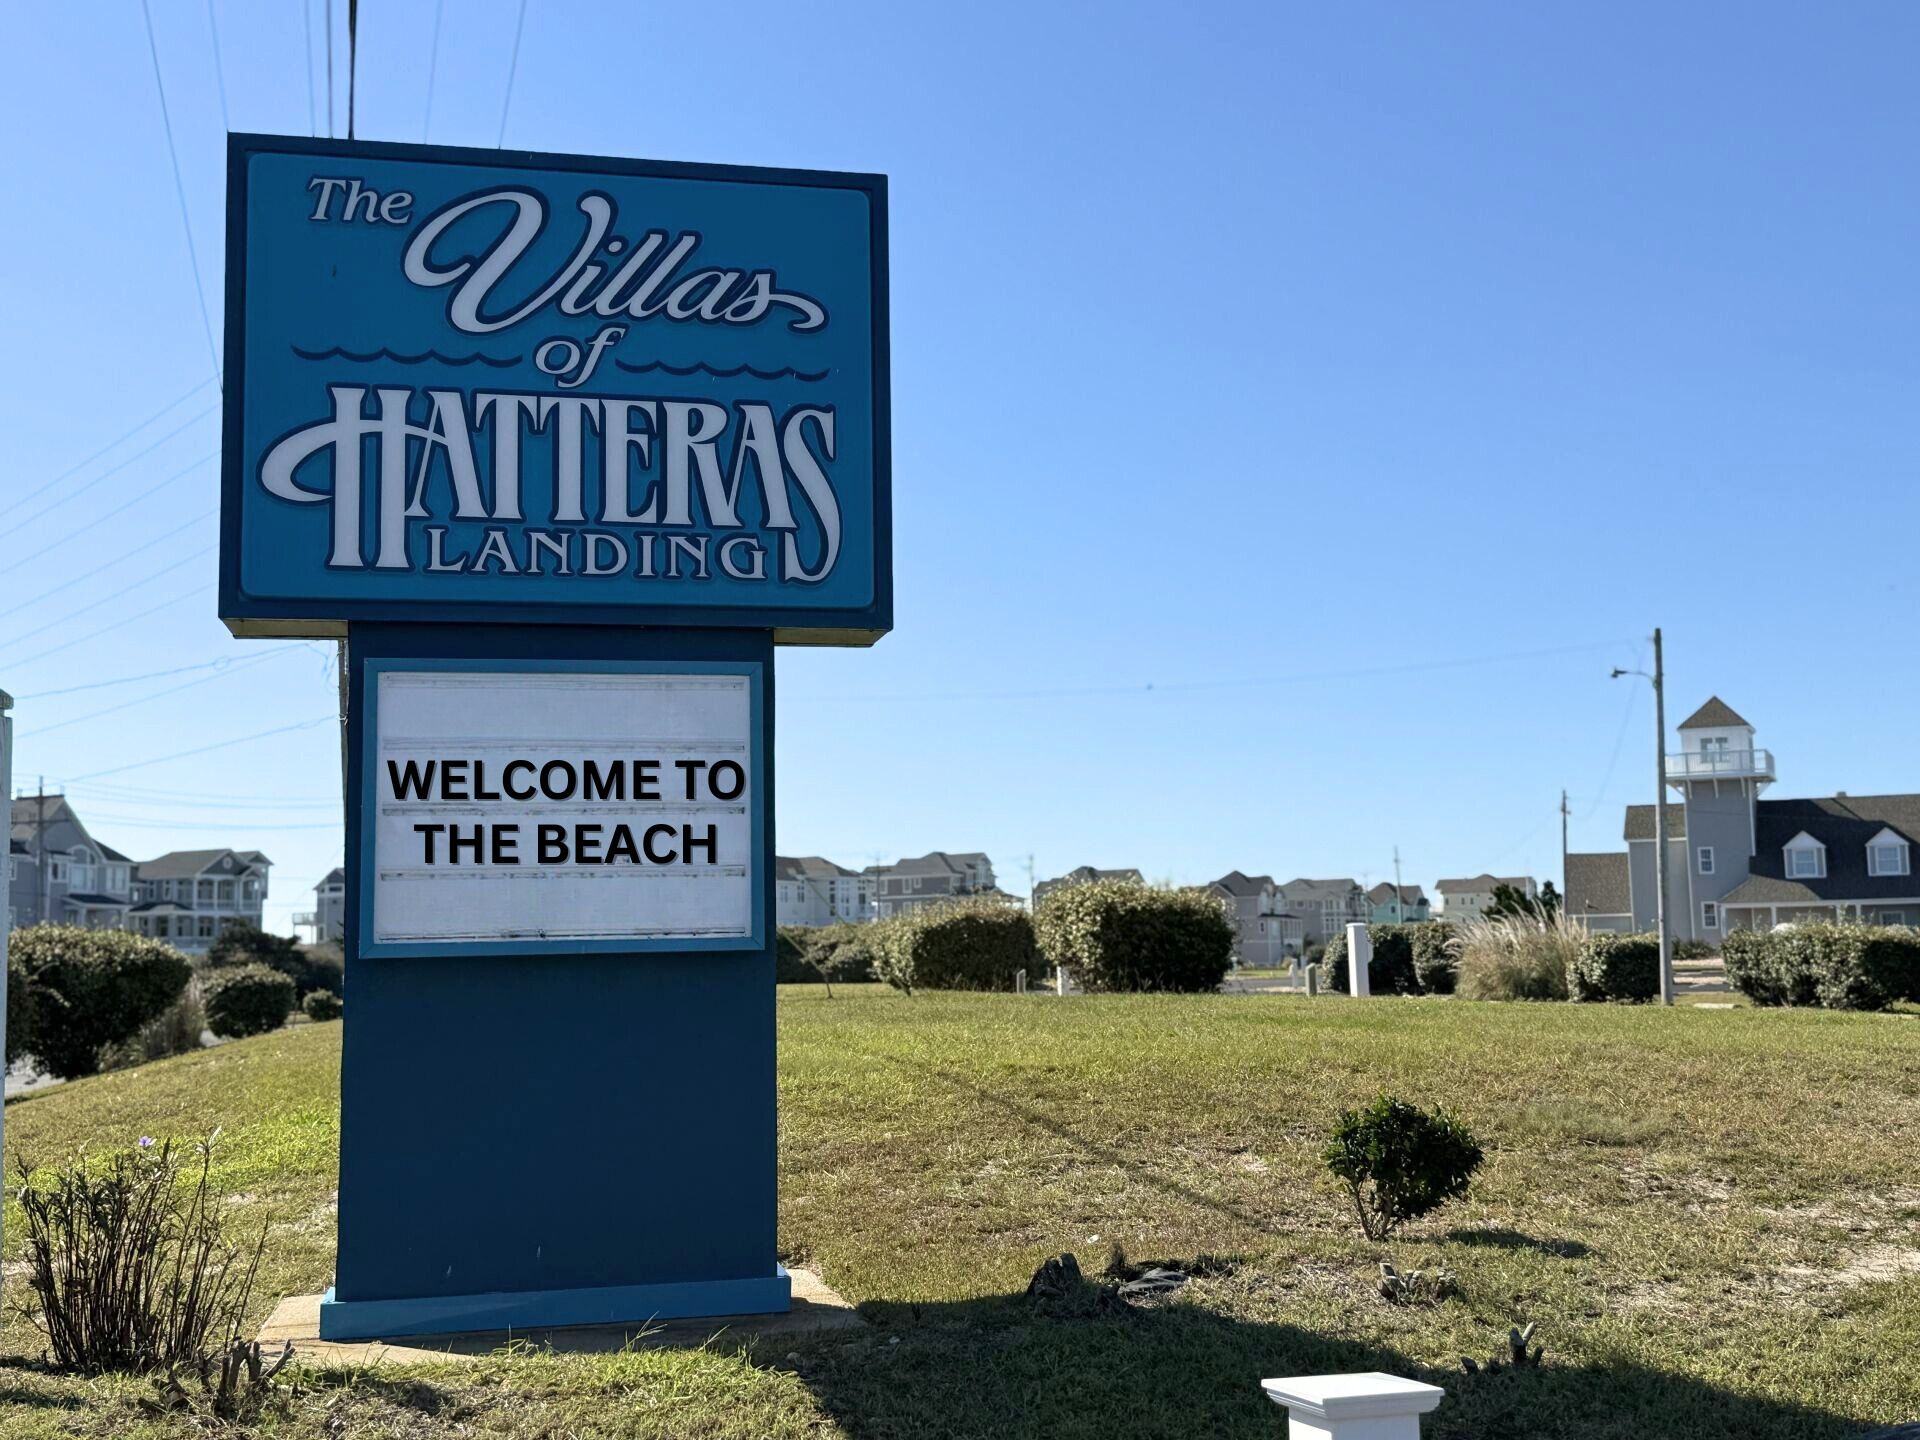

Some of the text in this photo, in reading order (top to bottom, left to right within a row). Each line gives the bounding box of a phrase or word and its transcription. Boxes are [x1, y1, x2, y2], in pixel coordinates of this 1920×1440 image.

[308, 177, 413, 225] The
[403, 191, 826, 334] Villas
[534, 327, 625, 389] of
[261, 386, 841, 583] HATTERAS
[426, 529, 767, 580] LANDING
